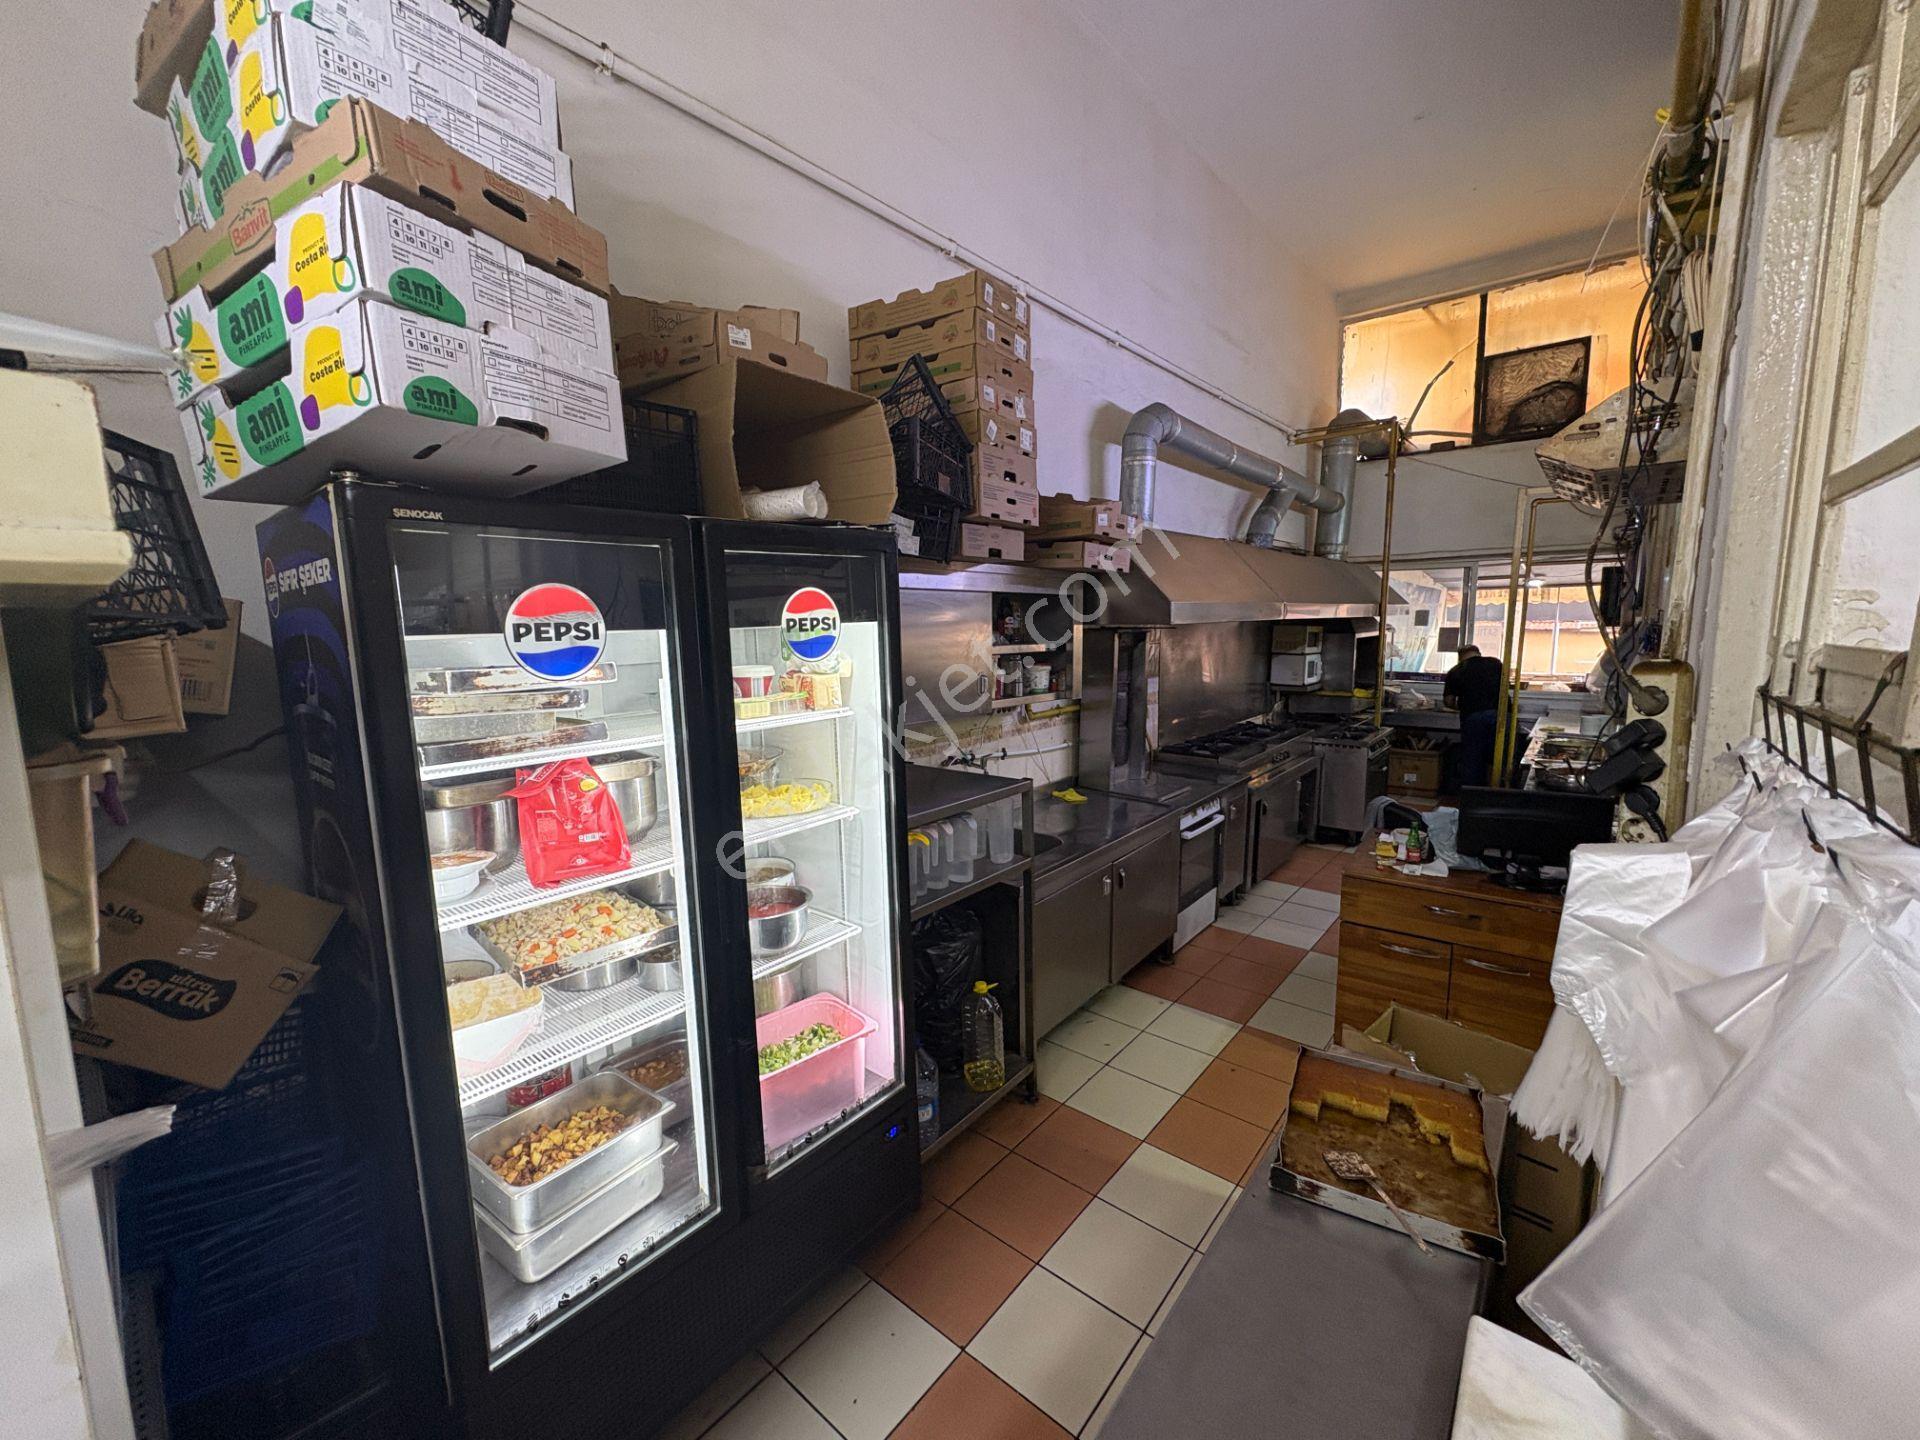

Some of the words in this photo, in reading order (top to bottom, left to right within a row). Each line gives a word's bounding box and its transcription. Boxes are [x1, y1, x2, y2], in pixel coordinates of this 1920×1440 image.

[231, 205, 268, 248] Banvit
[392, 218, 399, 226] 4
[406, 222, 412, 231] 5
[419, 228, 425, 237] 6
[432, 234, 437, 242] 7
[444, 240, 450, 248] 8
[394, 229, 400, 238] 9
[404, 234, 415, 244] 10
[419, 240, 427, 250] 11
[431, 245, 440, 255] 12
[295, 251, 318, 272] Costa
[396, 275, 444, 306] ami
[402, 293, 440, 311] PINEAPPLE
[228, 279, 272, 345] ami
[238, 327, 272, 357] PINEAPPLE
[406, 328, 413, 336] 4
[419, 331, 426, 339] 5
[432, 335, 439, 343] 6
[445, 338, 451, 346] 7
[458, 342, 464, 350] 8
[408, 340, 414, 348] 9
[418, 342, 429, 352] 10
[433, 346, 441, 355] 11
[445, 349, 454, 358] 12
[310, 365, 334, 382] Costa
[411, 385, 457, 410] ami
[416, 401, 454, 415] PINEAPPLE
[247, 386, 290, 445] ami
[299, 557, 332, 595] ŞEKER
[512, 621, 600, 642] PEPSI
[786, 616, 836, 633] PEPSI
[115, 968, 219, 1012] Berrak
[170, 974, 214, 991] ultra
